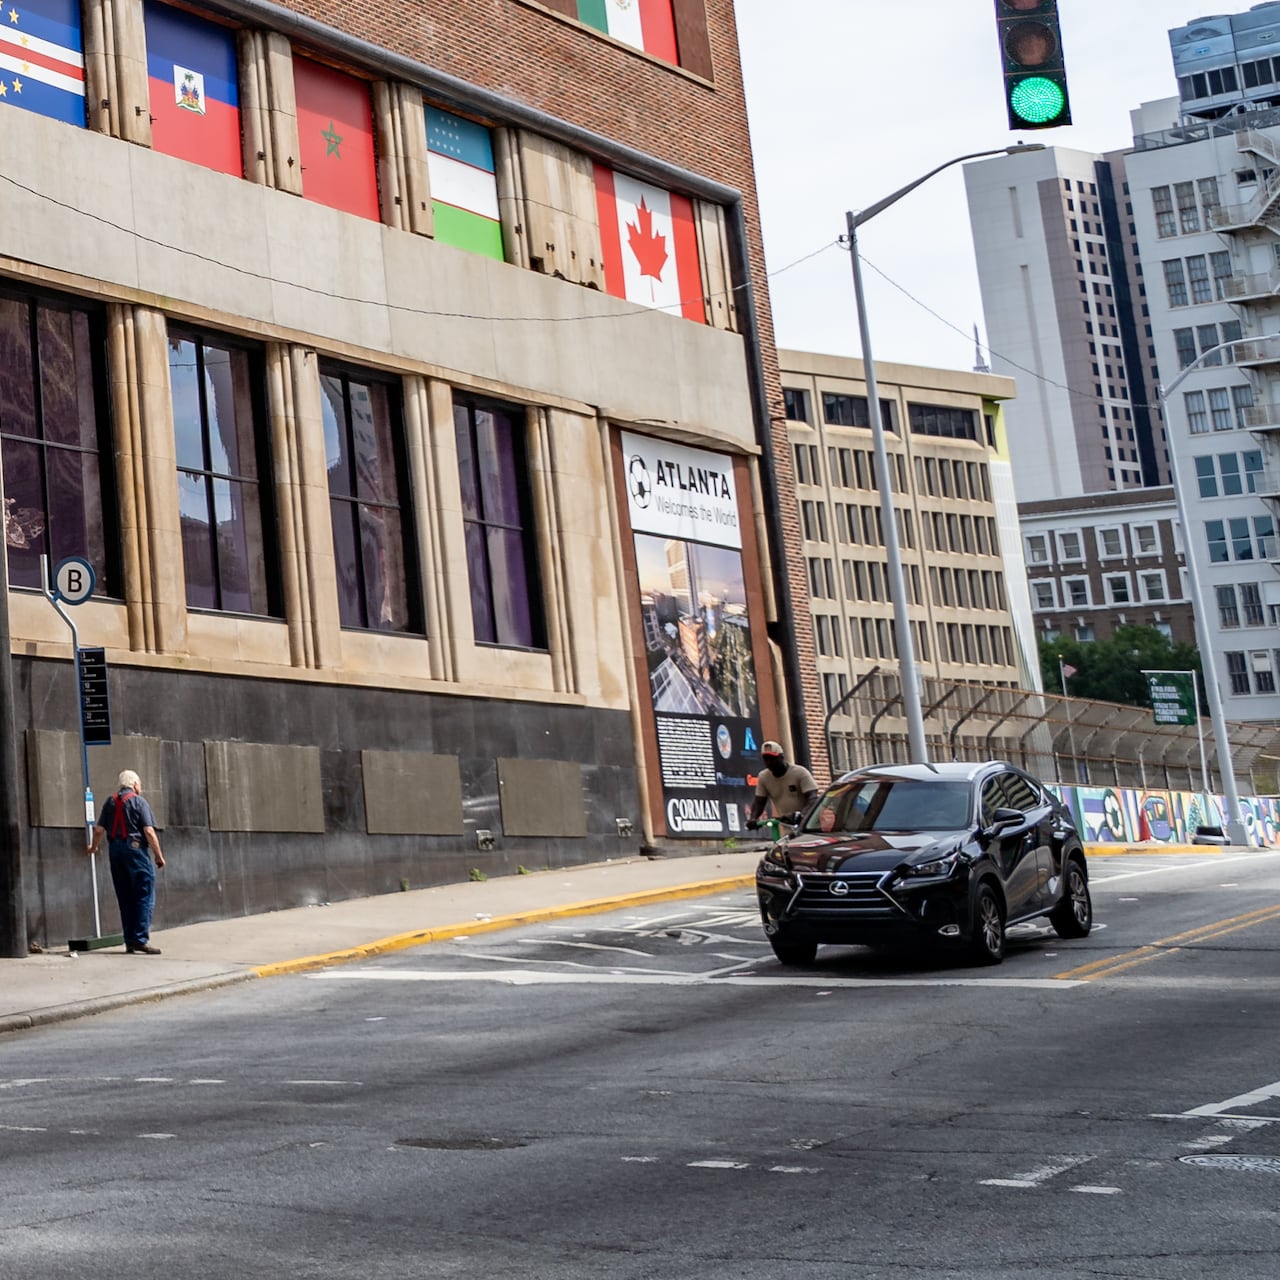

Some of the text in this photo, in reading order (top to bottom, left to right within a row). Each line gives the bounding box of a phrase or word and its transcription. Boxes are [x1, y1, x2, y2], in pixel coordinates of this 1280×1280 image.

[656, 459, 731, 500] ATLANTA
[655, 495, 737, 527] Welcomes the World
[67, 569, 82, 593] B
[667, 798, 721, 832] GORMAN
